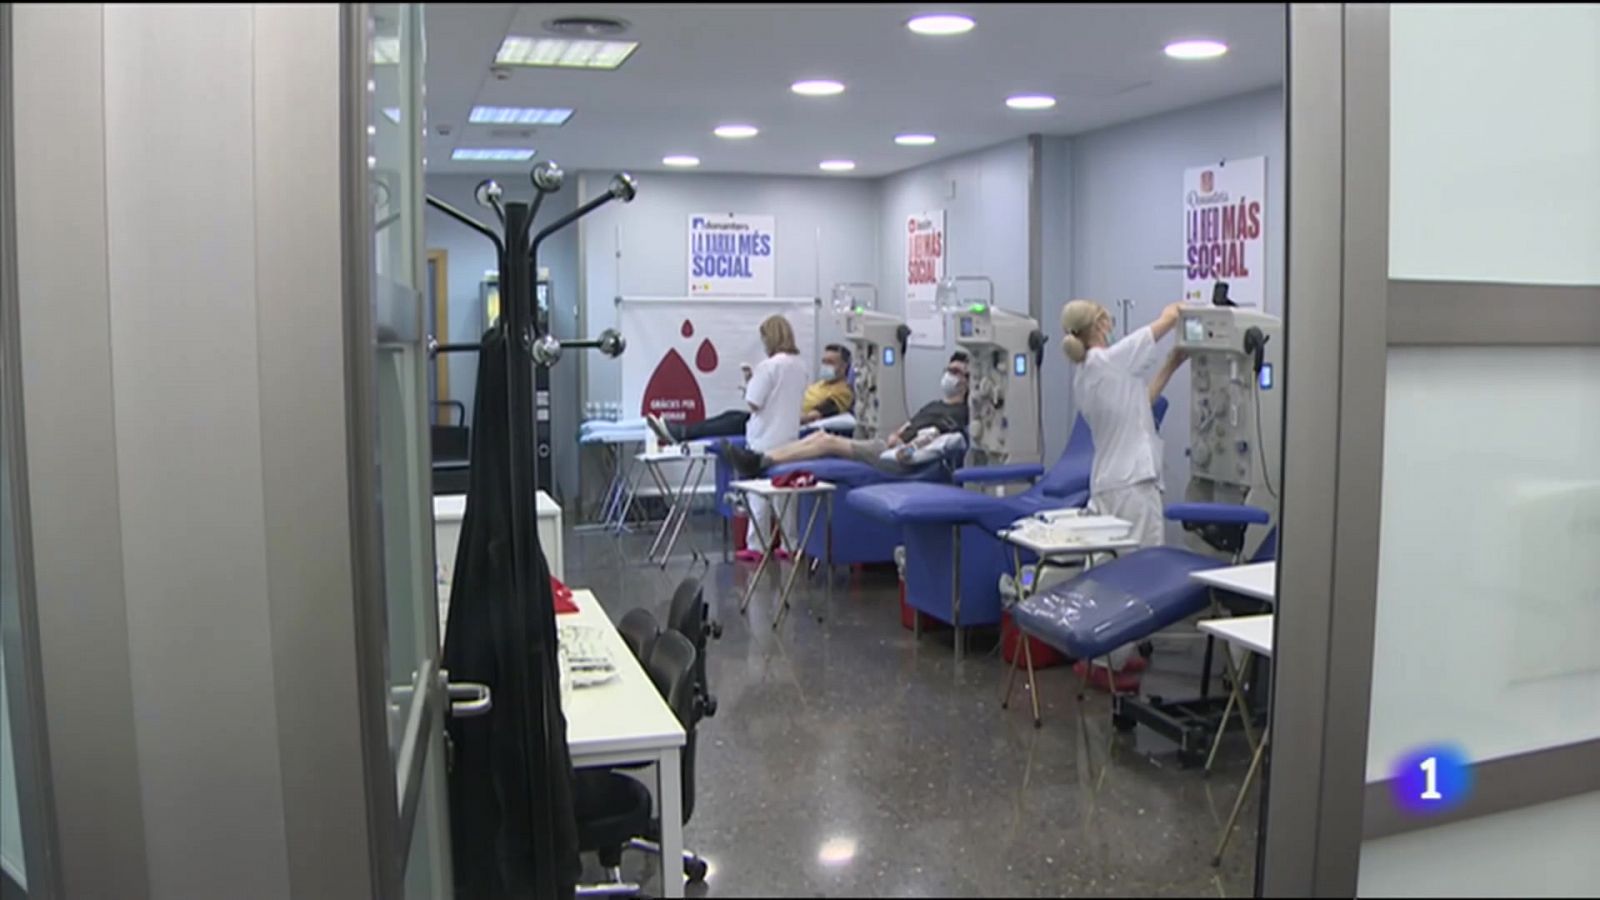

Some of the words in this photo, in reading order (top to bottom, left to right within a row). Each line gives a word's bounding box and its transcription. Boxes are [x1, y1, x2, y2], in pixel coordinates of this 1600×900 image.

[1221, 196, 1260, 240] MÁS
[738, 230, 771, 256] MÉS
[692, 254, 752, 278] SOCIAL
[908, 259, 936, 284] SOCIAL
[1187, 241, 1248, 280] SOCIAL
